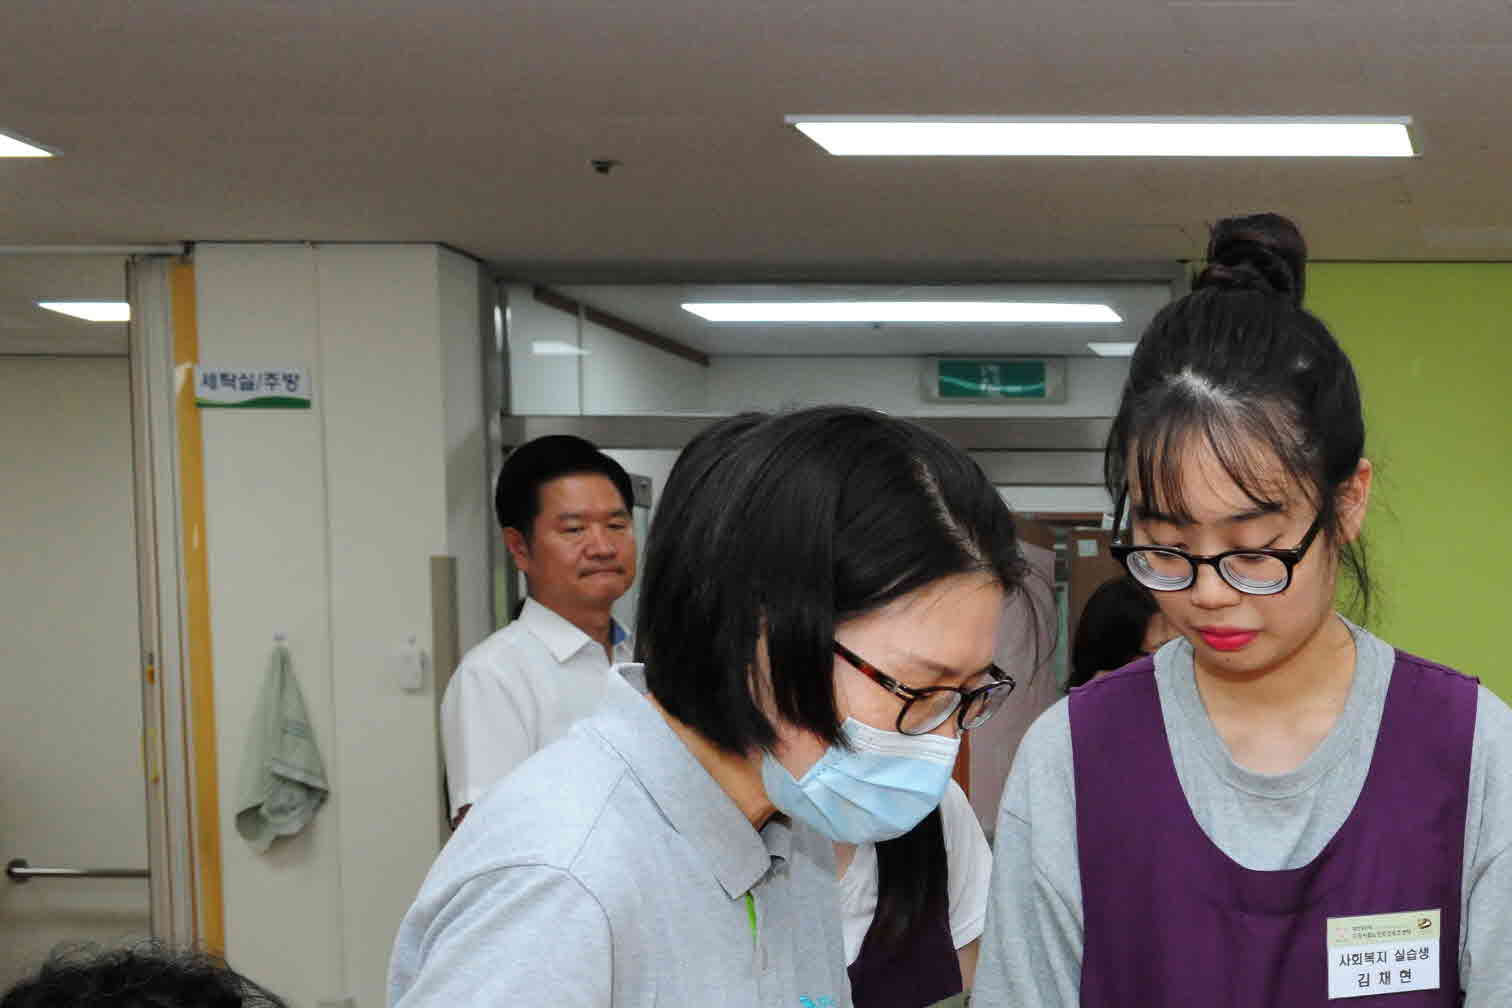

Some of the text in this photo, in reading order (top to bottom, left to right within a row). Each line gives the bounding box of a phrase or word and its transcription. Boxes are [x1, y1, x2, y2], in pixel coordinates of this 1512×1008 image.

[1339, 946, 1430, 967] 사회복지 실습생
[1358, 968, 1412, 988] 김 채 현
